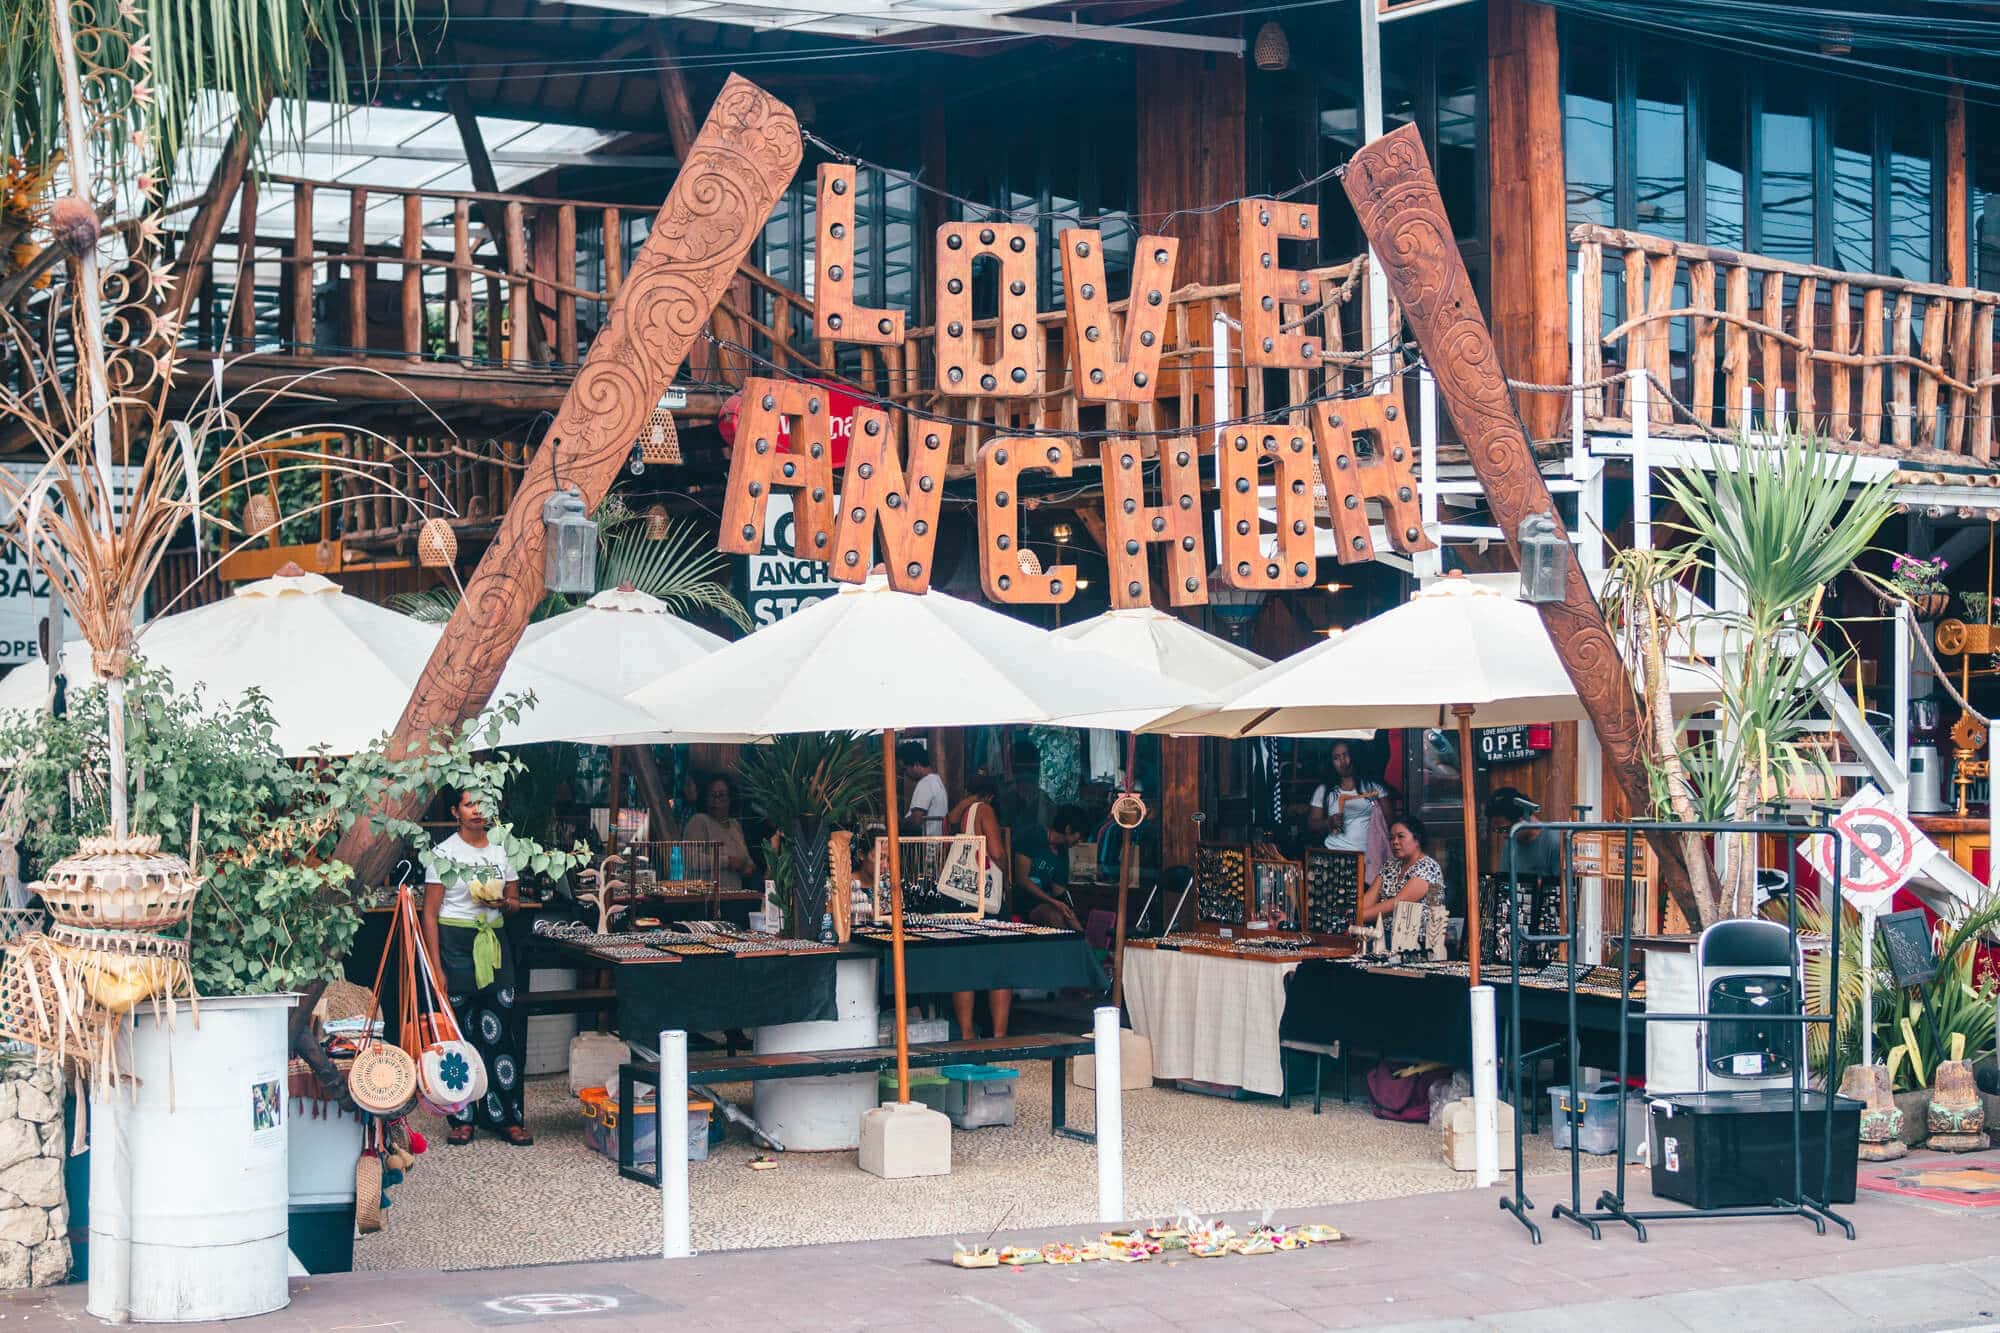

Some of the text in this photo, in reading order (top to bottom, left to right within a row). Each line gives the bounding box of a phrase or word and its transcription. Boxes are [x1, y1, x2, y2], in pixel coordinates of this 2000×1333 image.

[816, 162, 1323, 402] LOVE
[717, 376, 1438, 610] ANCHOR
[756, 561, 838, 586] ANCH
[1482, 733, 1528, 753] OPE
